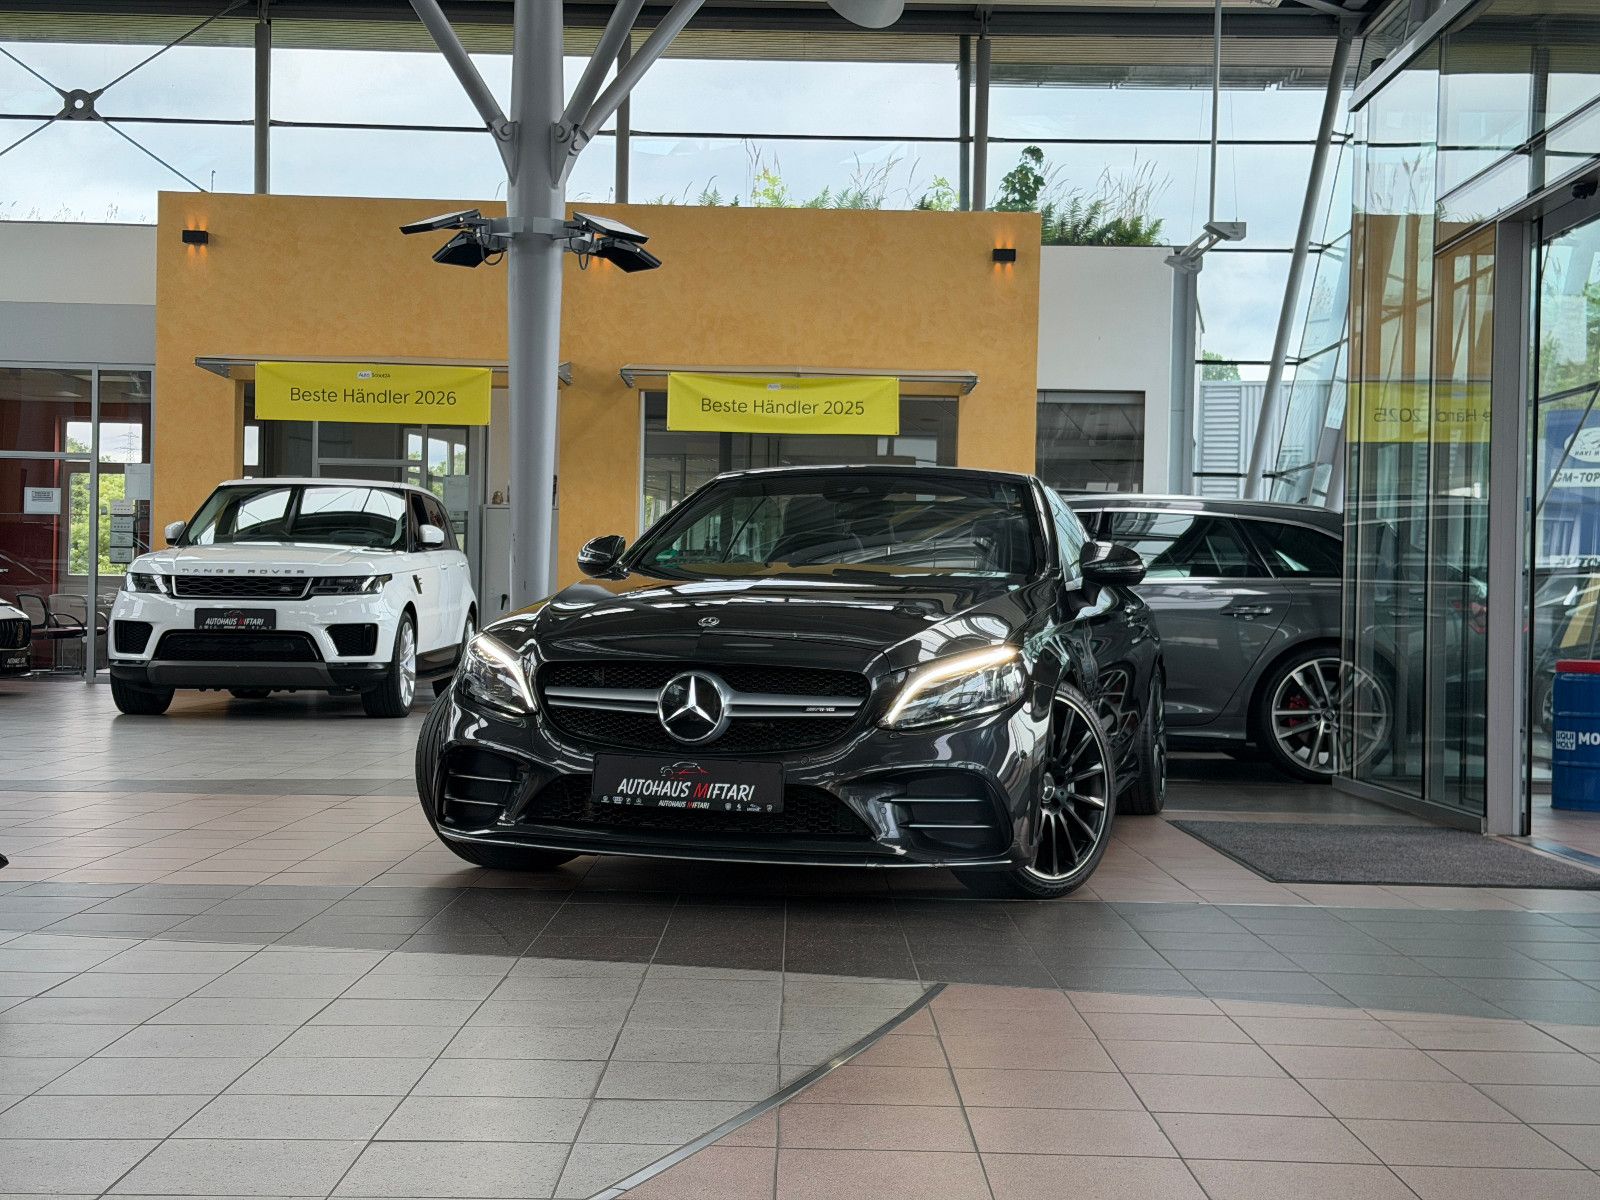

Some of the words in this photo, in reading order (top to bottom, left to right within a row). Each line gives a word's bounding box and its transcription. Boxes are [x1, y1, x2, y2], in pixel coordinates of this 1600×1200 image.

[290, 387, 338, 402] Beste
[343, 388, 411, 405] Händler
[414, 390, 457, 406] 2026
[701, 398, 748, 413] Beste
[753, 399, 819, 415] Händler
[823, 400, 865, 416] 2025
[205, 617, 238, 625] AUTOHAUS
[617, 778, 691, 798] AUTOHAUS
[693, 782, 756, 802] MIFTARI
[658, 799, 686, 808] AUTOHAUS
[687, 801, 710, 810] MIFTARI
